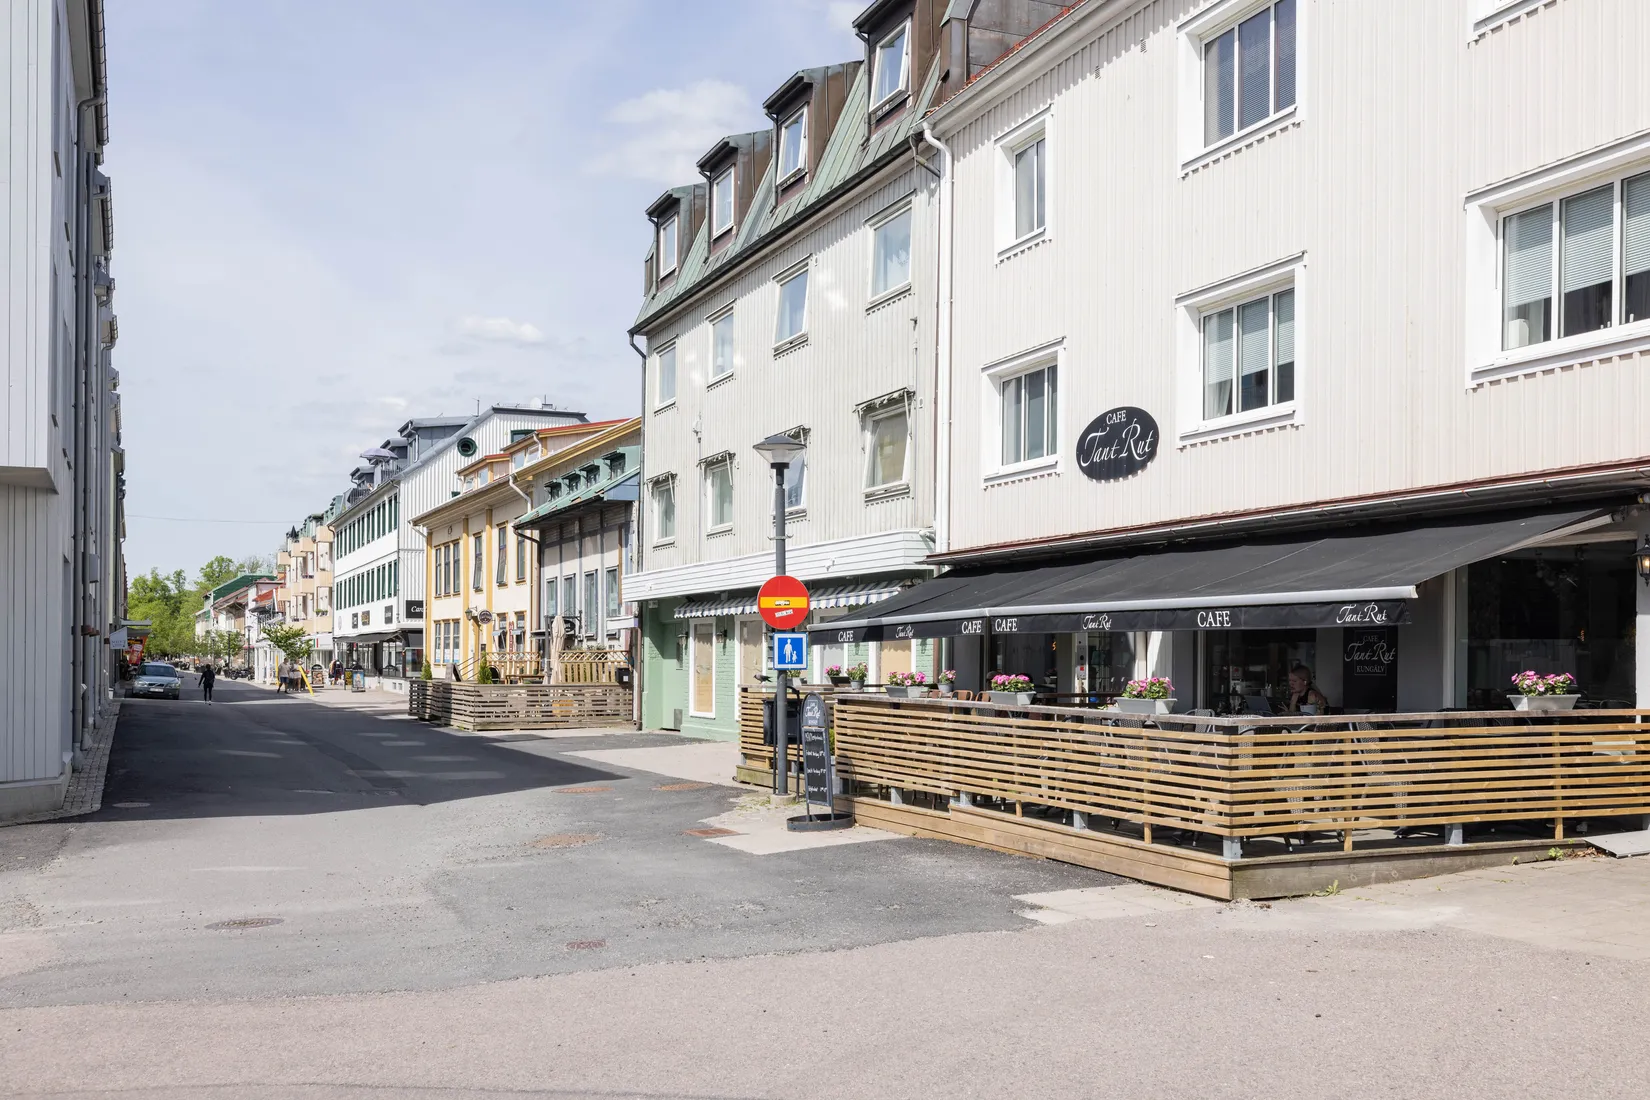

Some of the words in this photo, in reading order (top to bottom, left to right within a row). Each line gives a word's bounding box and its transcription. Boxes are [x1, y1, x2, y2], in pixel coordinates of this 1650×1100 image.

[1106, 410, 1127, 425] CAFE
[1080, 427, 1120, 467] Tant
[1119, 418, 1154, 460] Rut
[1197, 610, 1232, 627] CAFE
[1336, 604, 1363, 623] Tant
[1362, 602, 1388, 624] Rut
[961, 620, 982, 634] CAFE
[995, 618, 1018, 632] CAFE
[838, 630, 854, 642] CAFE
[1344, 641, 1373, 662] Tant
[1371, 640, 1396, 664] Rut
[1356, 664, 1385, 673] KUNGÄLV
